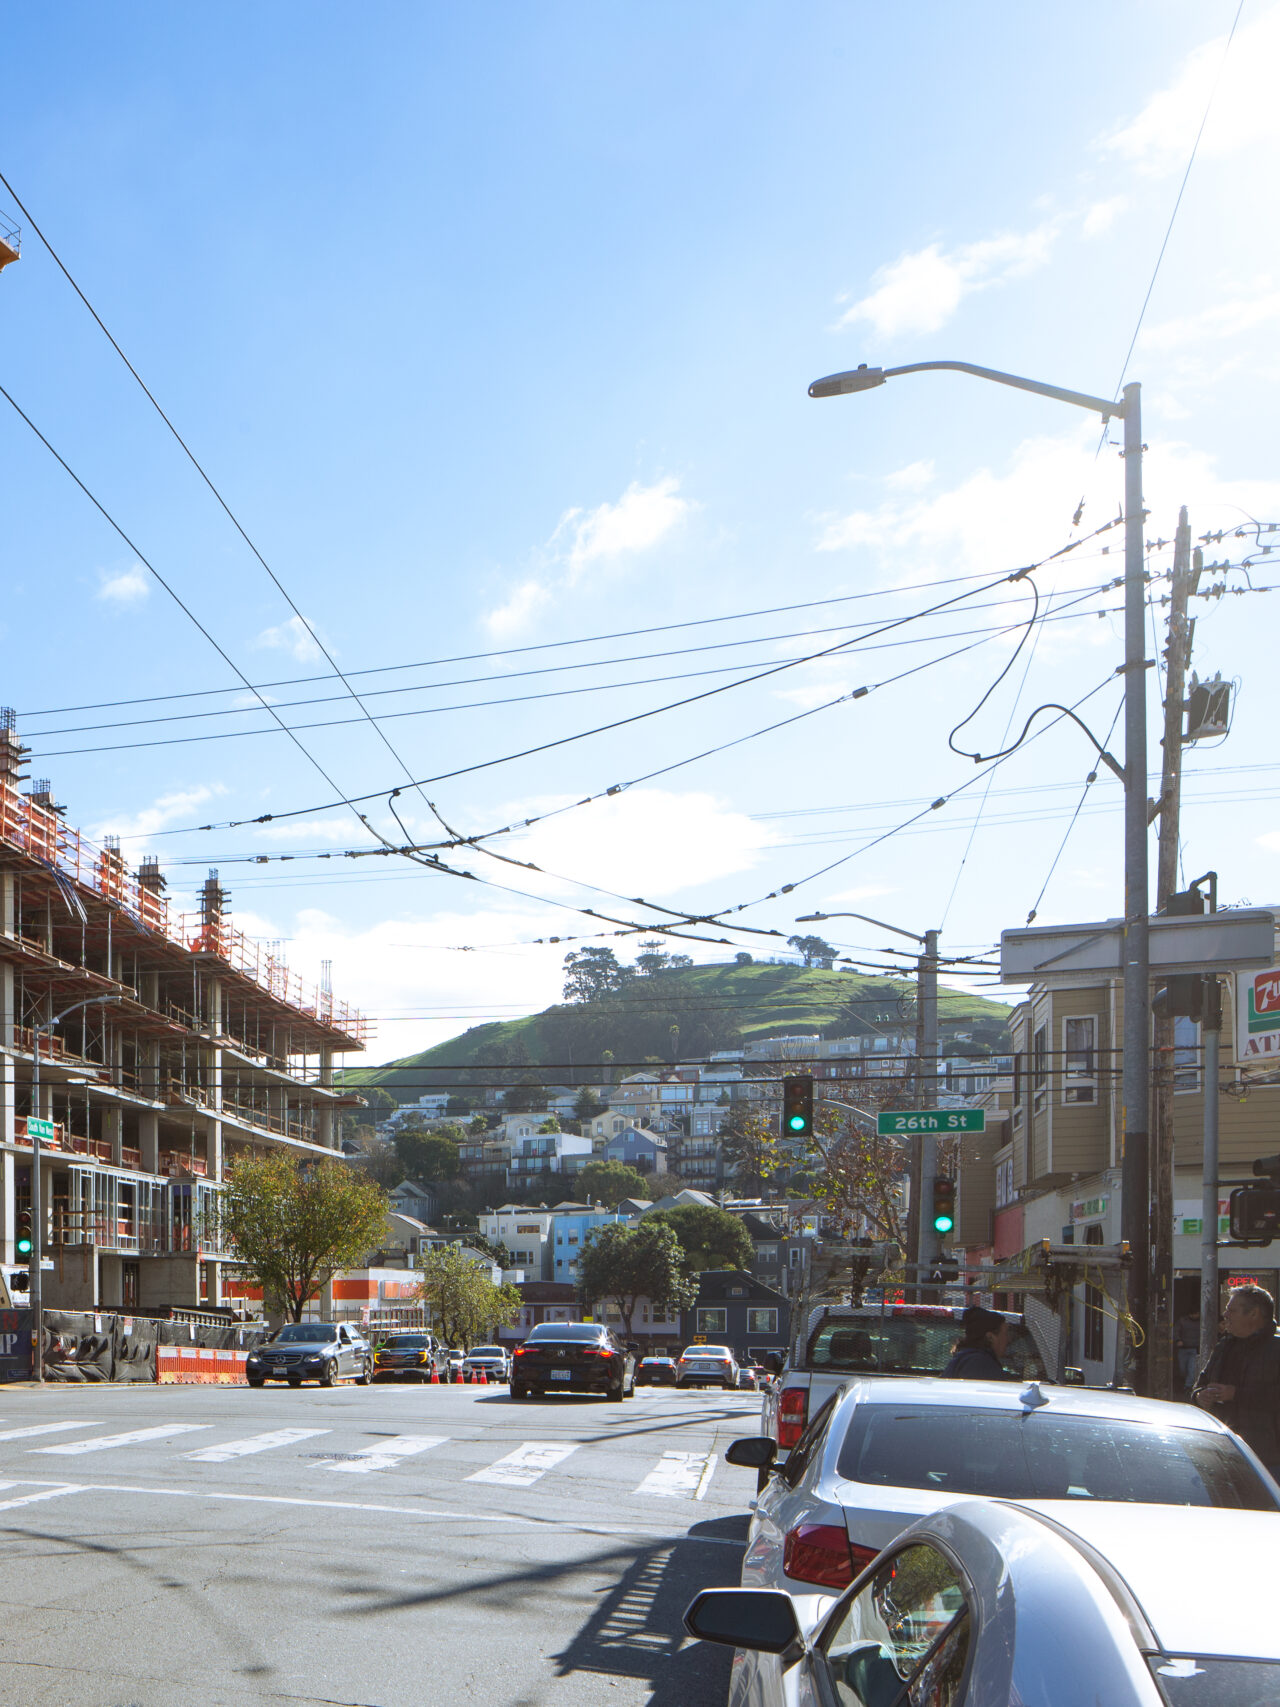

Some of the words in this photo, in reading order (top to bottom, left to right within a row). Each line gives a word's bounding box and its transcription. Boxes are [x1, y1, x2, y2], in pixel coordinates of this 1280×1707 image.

[1243, 1034, 1280, 1056] AT
[895, 1116, 938, 1129] 26th
[947, 1115, 967, 1127] St
[1227, 1276, 1258, 1287] OPEN
